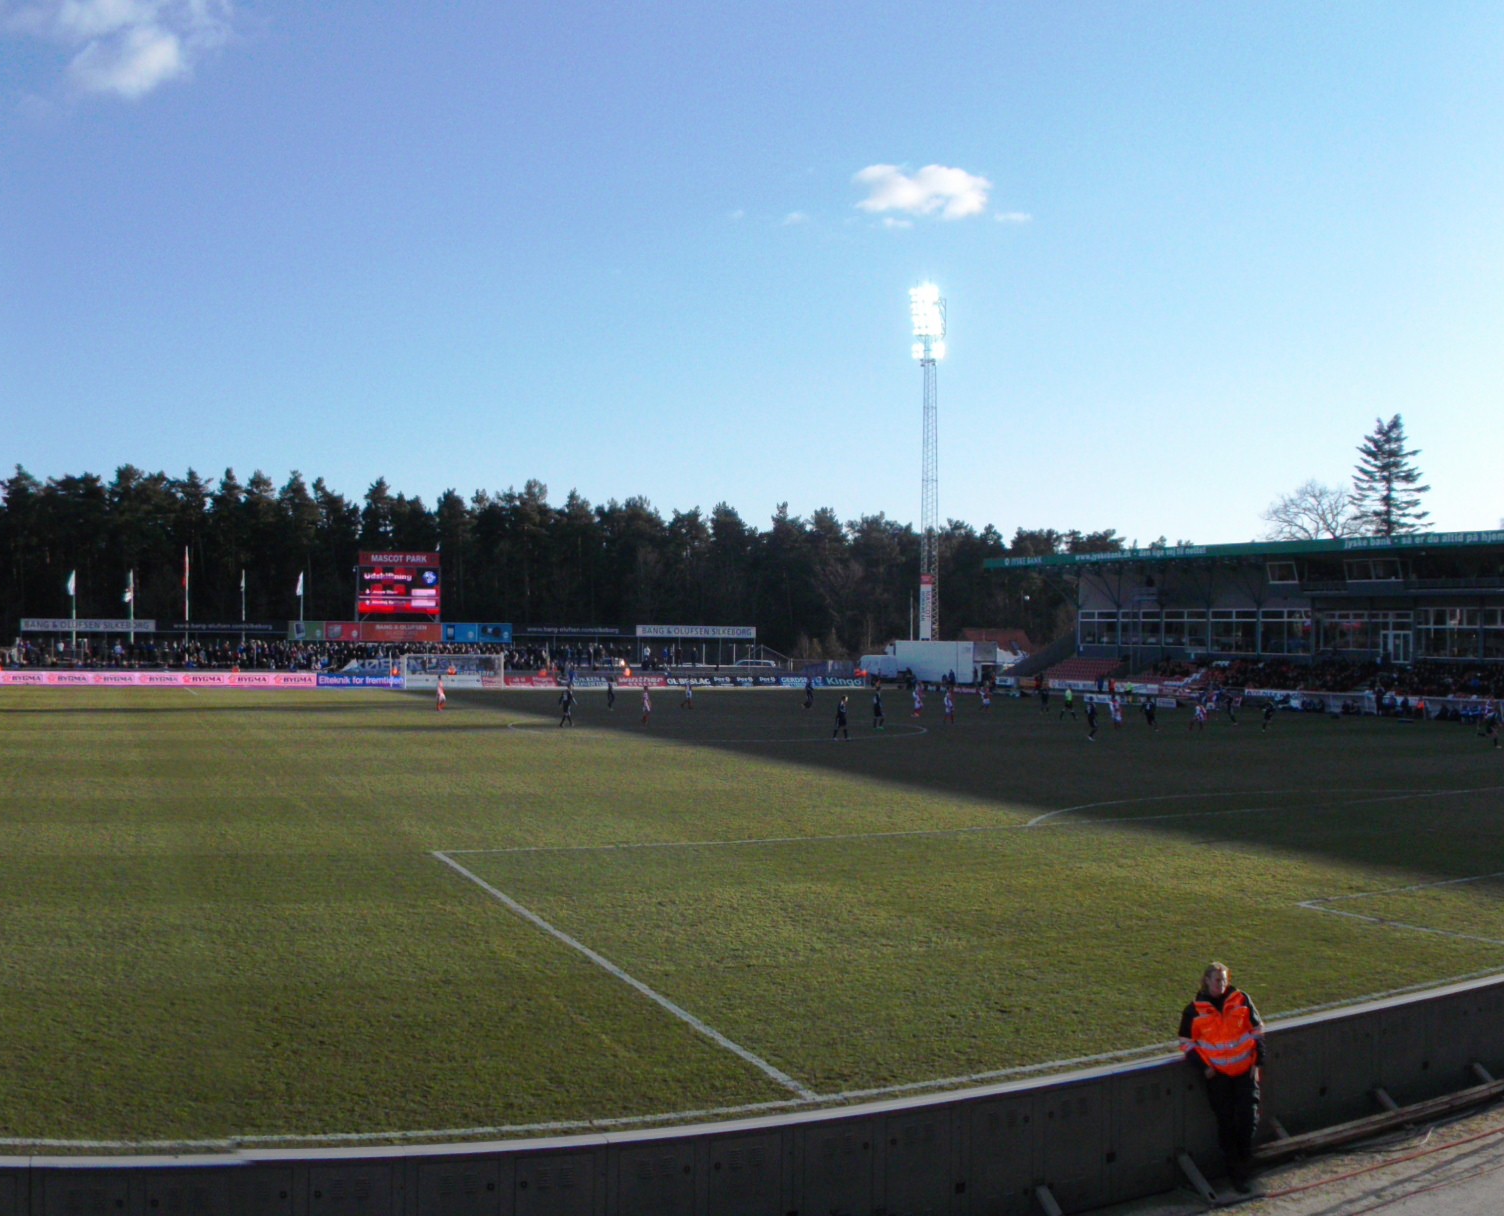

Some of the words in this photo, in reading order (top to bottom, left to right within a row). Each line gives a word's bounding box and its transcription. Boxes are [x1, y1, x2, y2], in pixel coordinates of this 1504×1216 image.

[1344, 538, 1368, 549] jyske
[1370, 537, 1392, 547] bank
[1401, 535, 1412, 545] så
[1416, 536, 1424, 544] er
[1427, 534, 1439, 543] du
[1441, 532, 1464, 543] altid
[1466, 532, 1479, 545] på
[371, 554, 403, 562] MASCOT
[406, 554, 427, 563] PARK
[641, 626, 664, 635] BANG
[674, 627, 709, 636] OLUFSEN
[712, 627, 752, 637] SILKEBORG
[352, 676, 364, 685] for
[825, 677, 862, 687] Kingo
